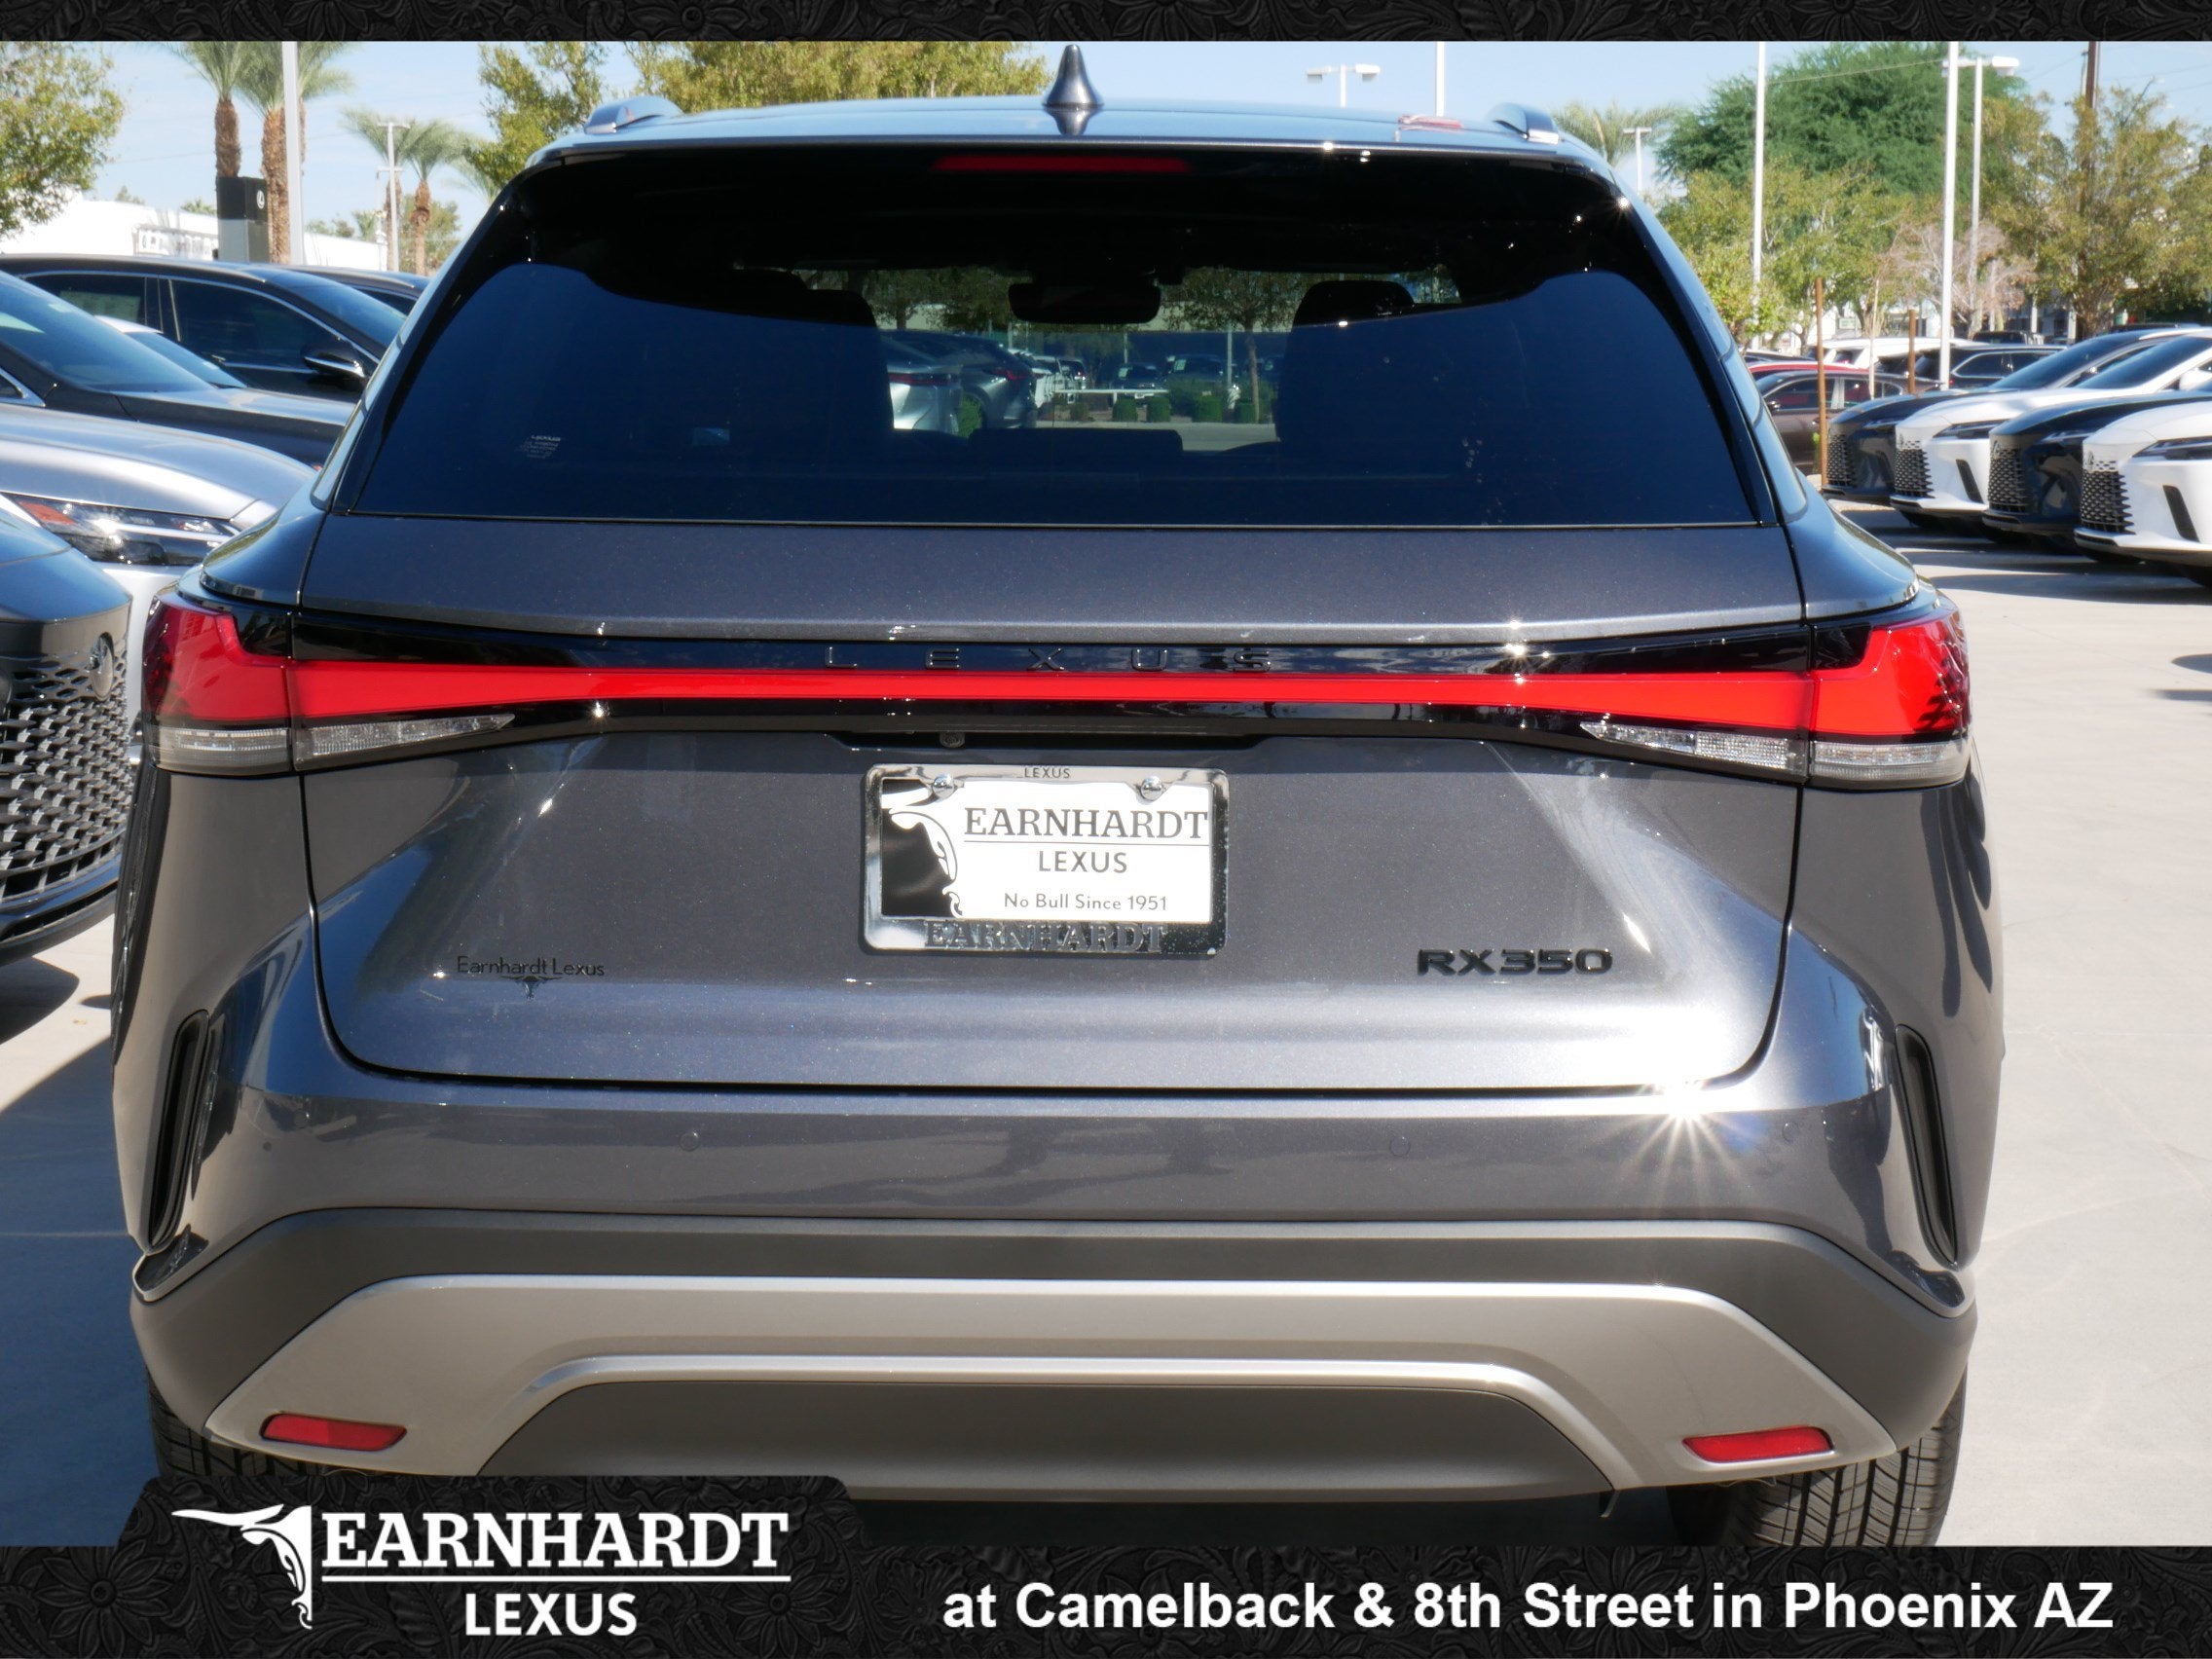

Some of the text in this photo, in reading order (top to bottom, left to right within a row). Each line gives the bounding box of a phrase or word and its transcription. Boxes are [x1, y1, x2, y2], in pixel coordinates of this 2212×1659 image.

[825, 646, 1272, 672] LEXUS
[1023, 765, 1070, 779] LEXUS
[964, 807, 1208, 839] EARNHARDT
[1038, 850, 1128, 873] LEXUS
[1004, 893, 1167, 911] No Bull Since 1951
[924, 921, 1166, 952] EARNHARDT
[457, 955, 605, 976] Earnhardt Lexus
[1417, 948, 1613, 976] RX350
